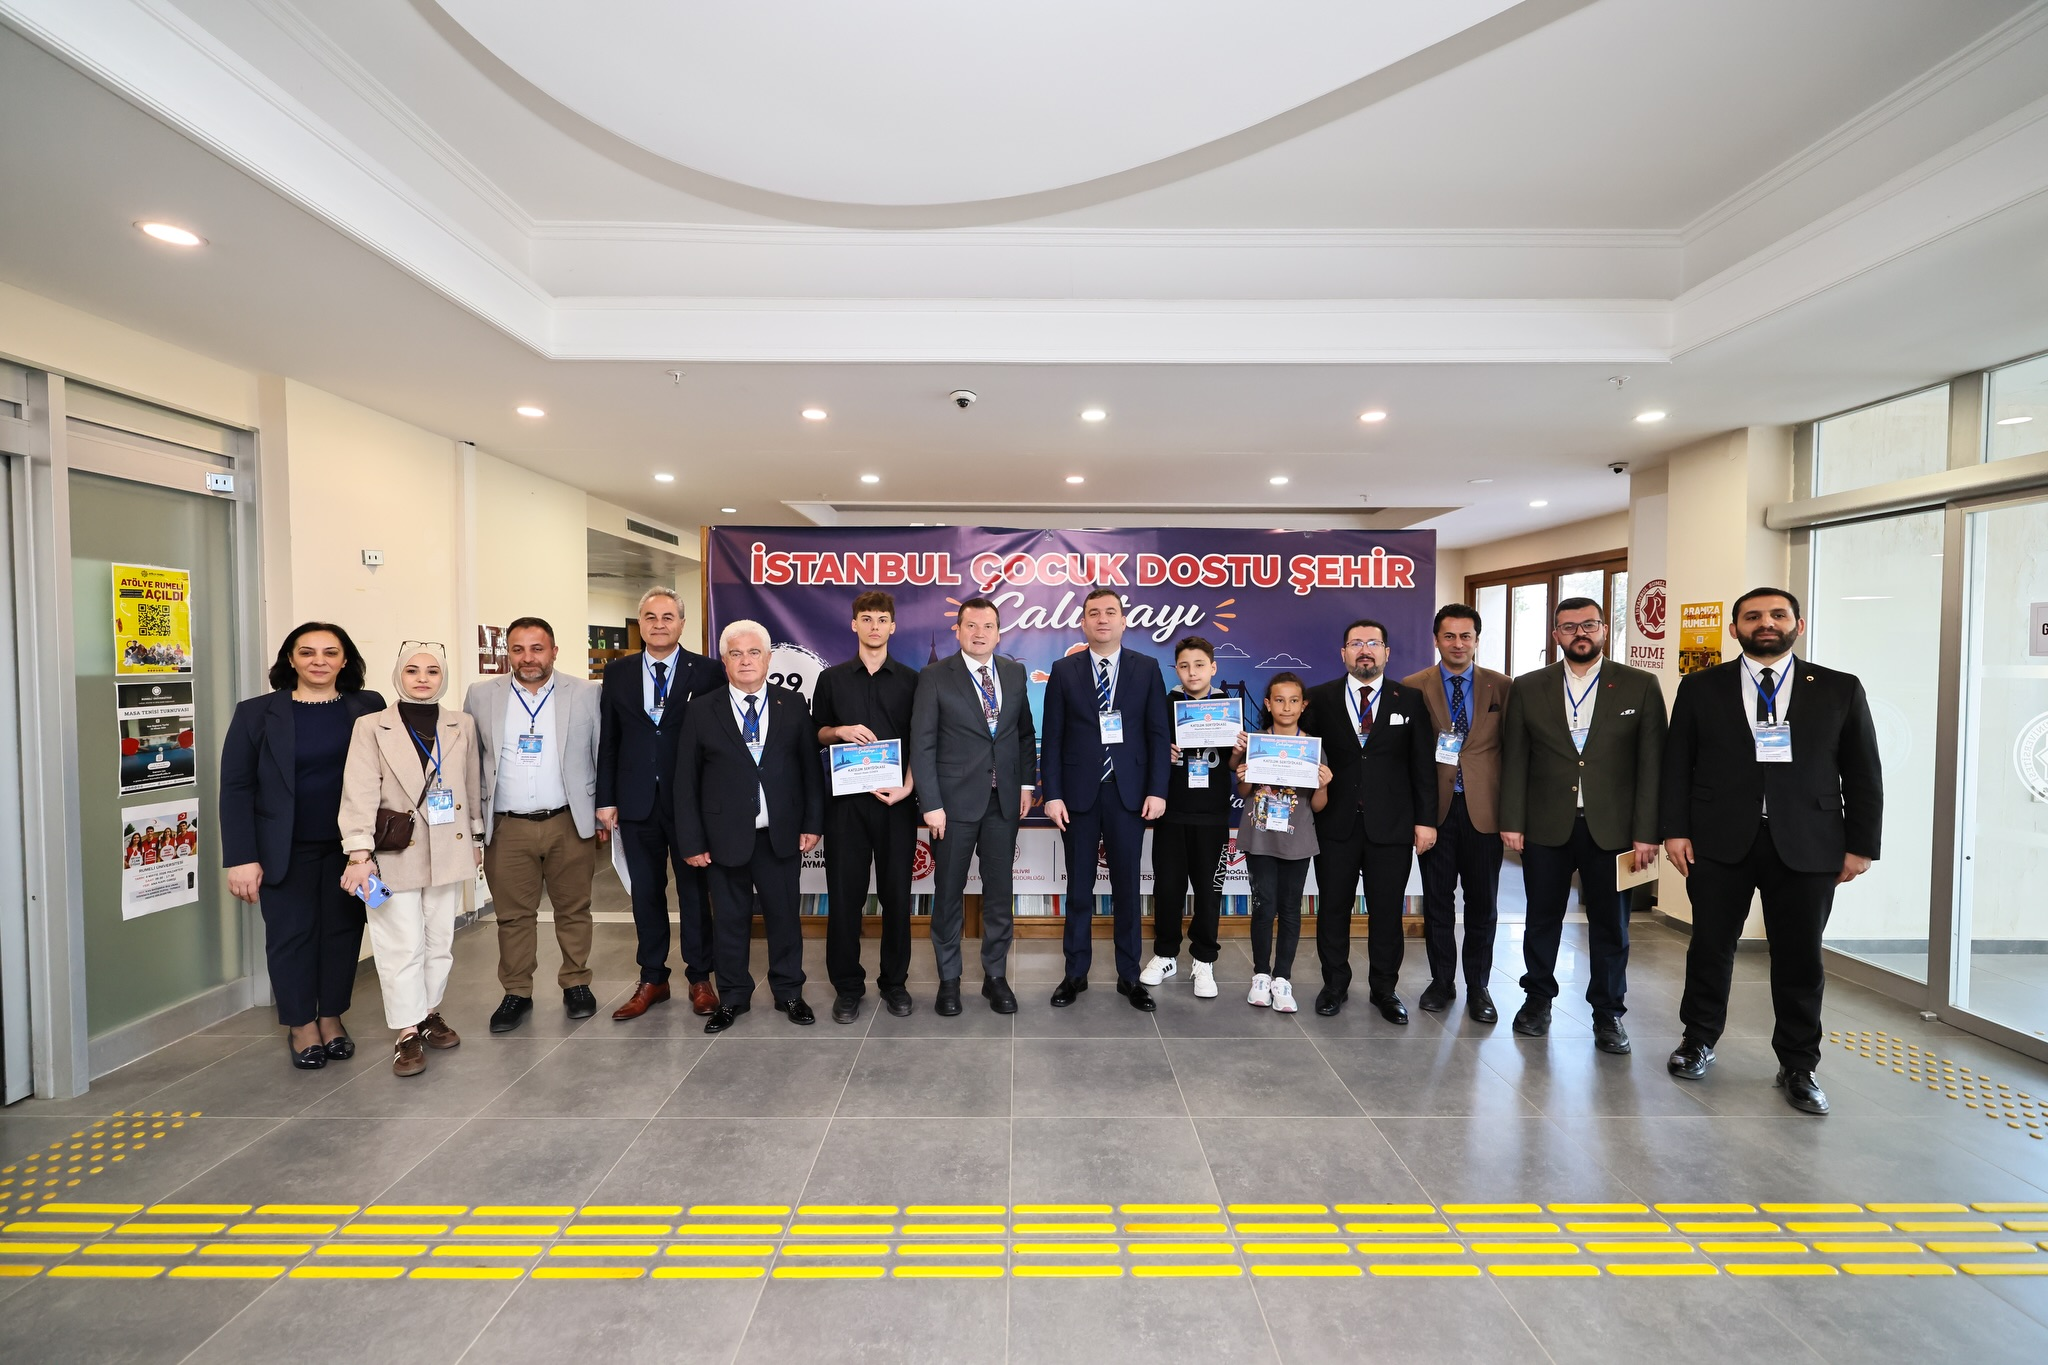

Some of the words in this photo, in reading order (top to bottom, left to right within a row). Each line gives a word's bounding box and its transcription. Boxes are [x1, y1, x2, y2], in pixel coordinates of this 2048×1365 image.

[751, 542, 961, 585] İSTANBUL
[970, 552, 1129, 593] ÇOCUK
[1137, 553, 1281, 587] DOSTU
[1288, 546, 1415, 596] ŞEHİR
[121, 578, 153, 588] ATÖLYE
[155, 580, 184, 590] RUMELİ
[145, 589, 184, 602] AÇILDI
[1682, 616, 1720, 628] RUMELİLİ
[1630, 646, 1664, 659] RUME
[1630, 659, 1664, 669] ÜNİVERSİ
[769, 672, 803, 692] 29
[156, 860, 184, 870] ÜNİVERSİTESİ
